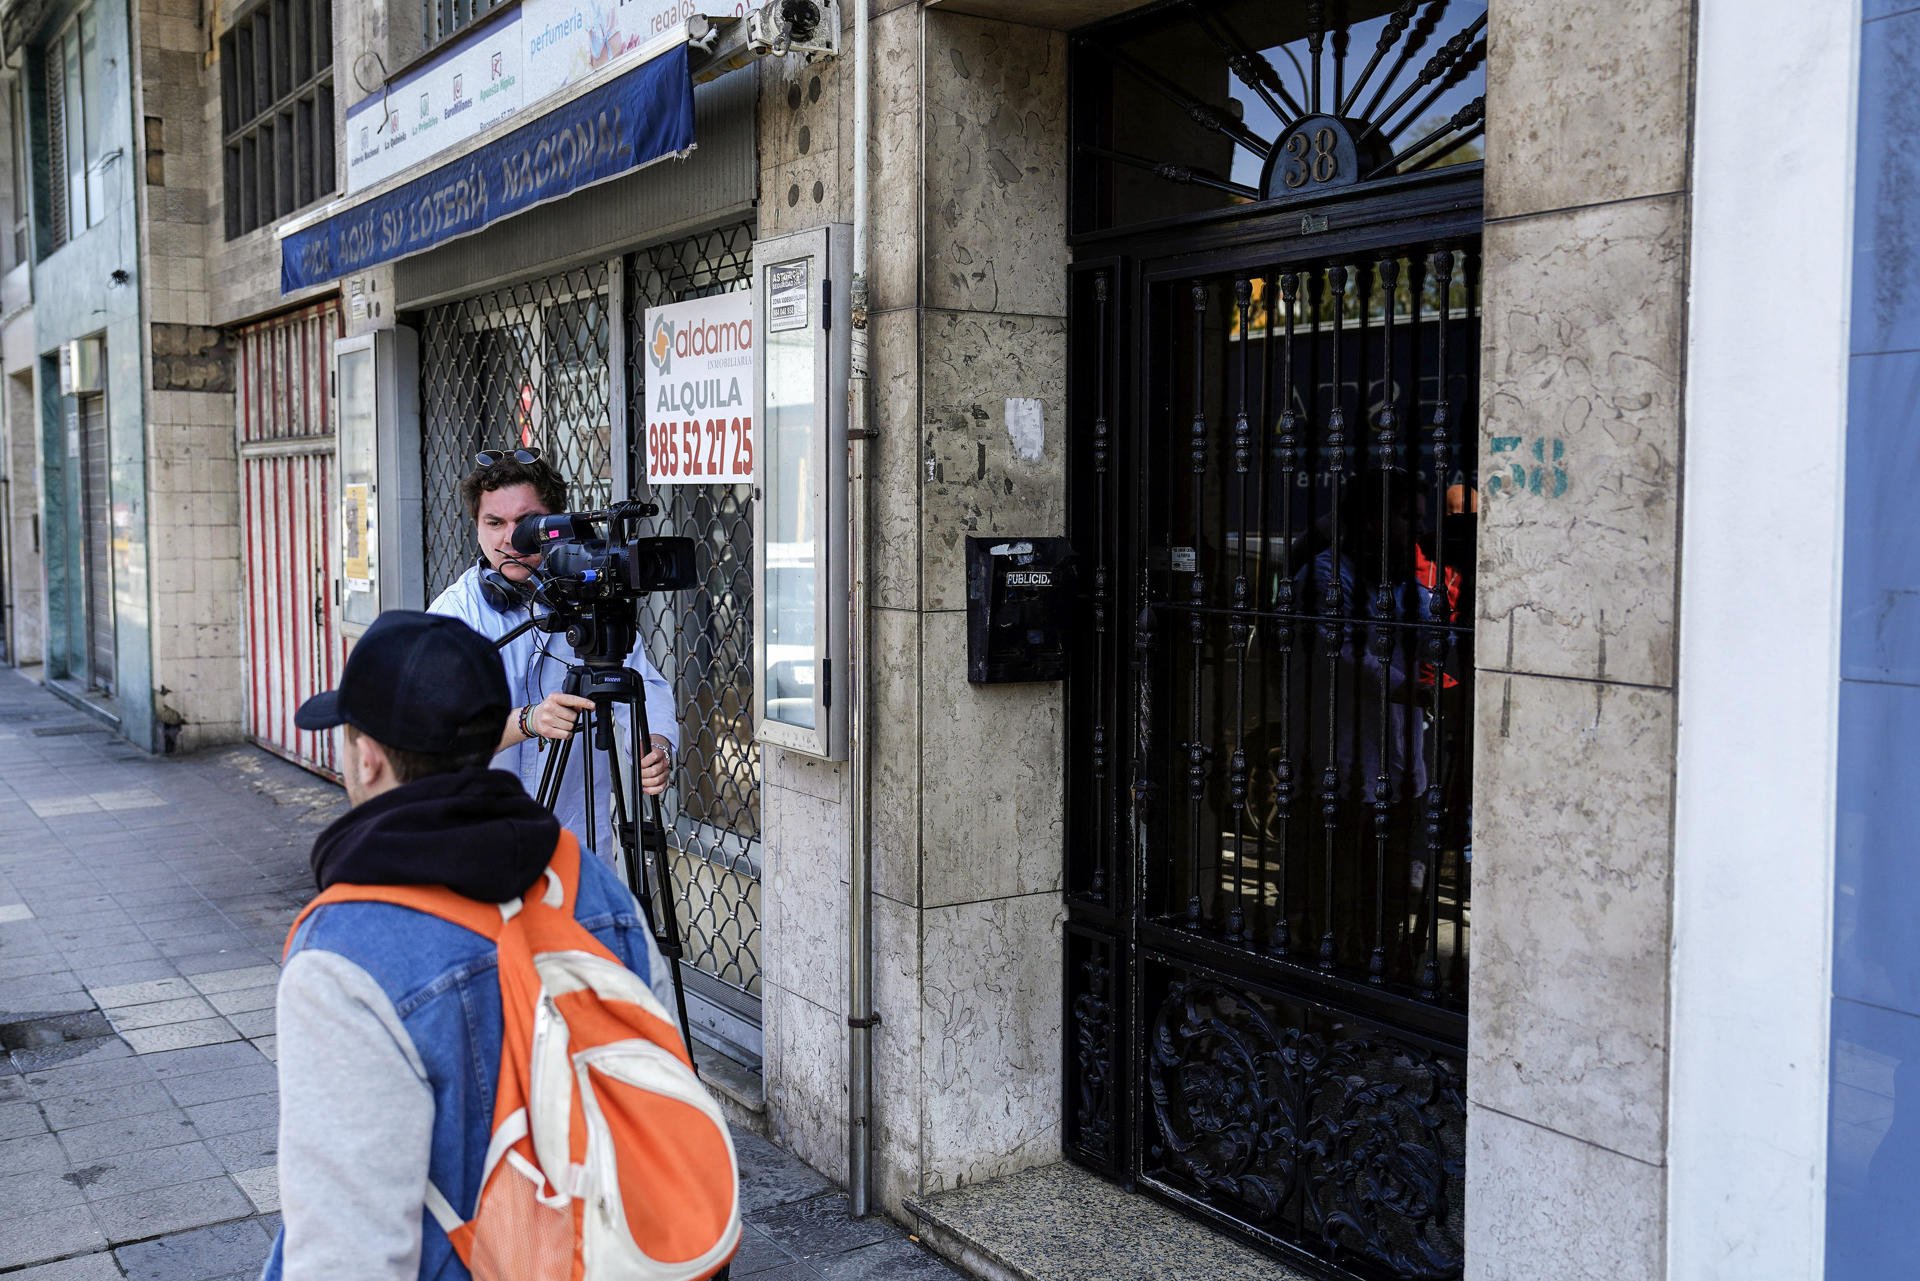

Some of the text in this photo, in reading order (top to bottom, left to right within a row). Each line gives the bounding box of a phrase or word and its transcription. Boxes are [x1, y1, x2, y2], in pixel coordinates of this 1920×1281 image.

[444, 97, 473, 120] EuroMillones
[384, 140, 391, 150] La
[1284, 127, 1338, 188] 38
[338, 208, 375, 265] AQUÍ
[382, 208, 404, 252] SU
[409, 162, 489, 243] LOTERÍA
[501, 105, 632, 203] NACIONAL
[676, 318, 752, 358] aldama
[707, 355, 753, 371] INMOBILIARIA
[657, 377, 742, 417] ALQUILA
[650, 417, 753, 477] 985 52 27 25
[1007, 573, 1051, 585] PUBLICID
